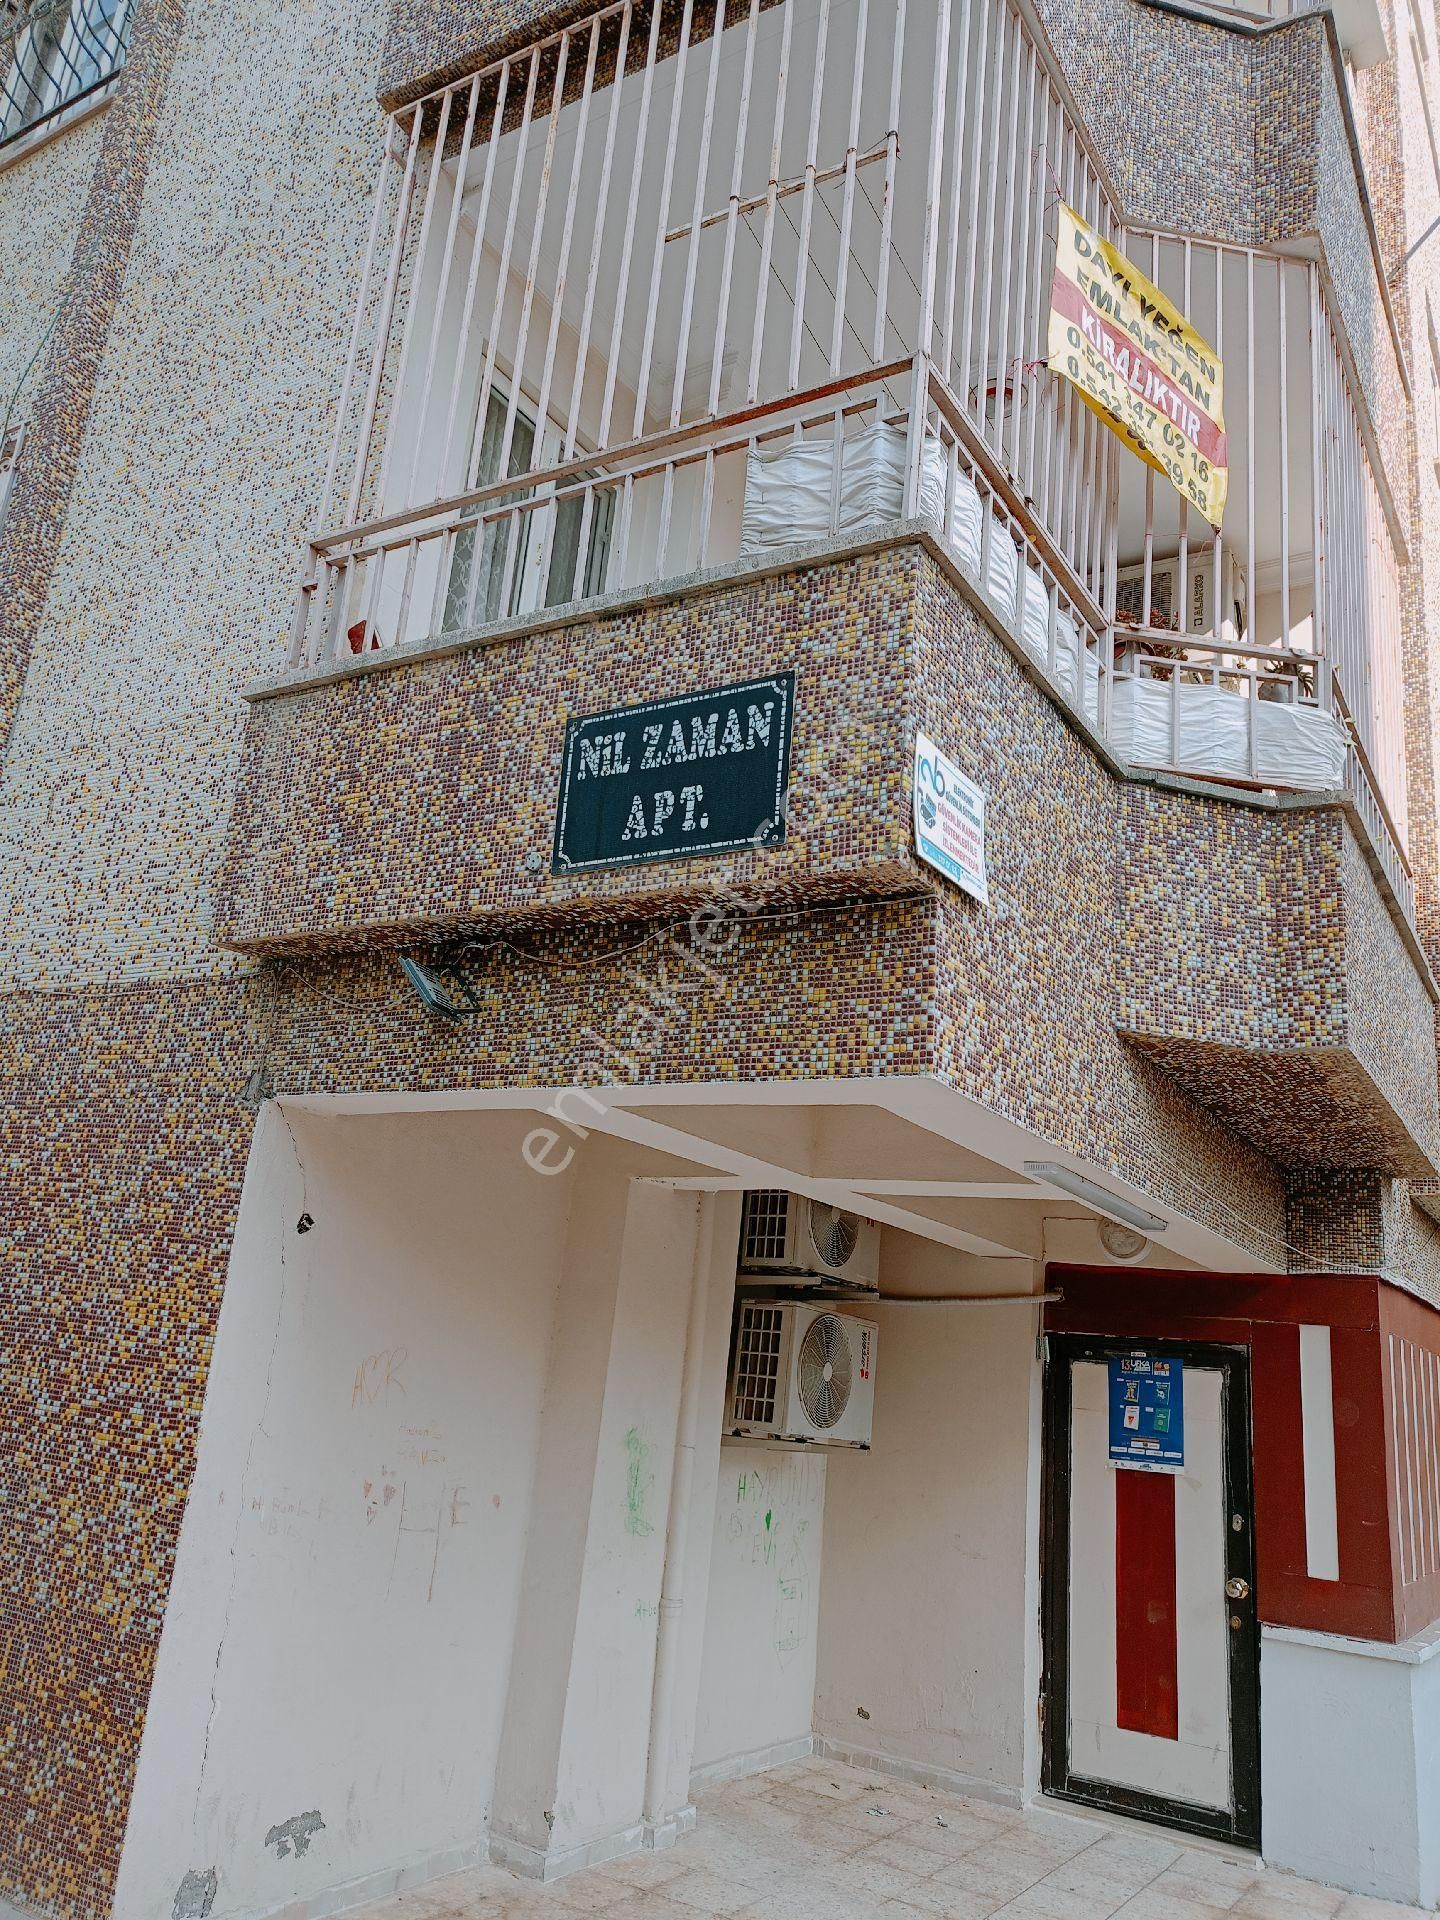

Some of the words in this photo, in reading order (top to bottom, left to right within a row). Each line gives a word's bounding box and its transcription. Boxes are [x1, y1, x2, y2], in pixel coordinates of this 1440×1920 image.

[1074, 228, 1131, 300] DAYI
[1139, 294, 1216, 385] YEĞEN
[1076, 265, 1211, 411] EMLAK'TAN
[1191, 452, 1209, 483] 16
[640, 701, 775, 770] ZAMAN
[621, 785, 710, 841] APT.
